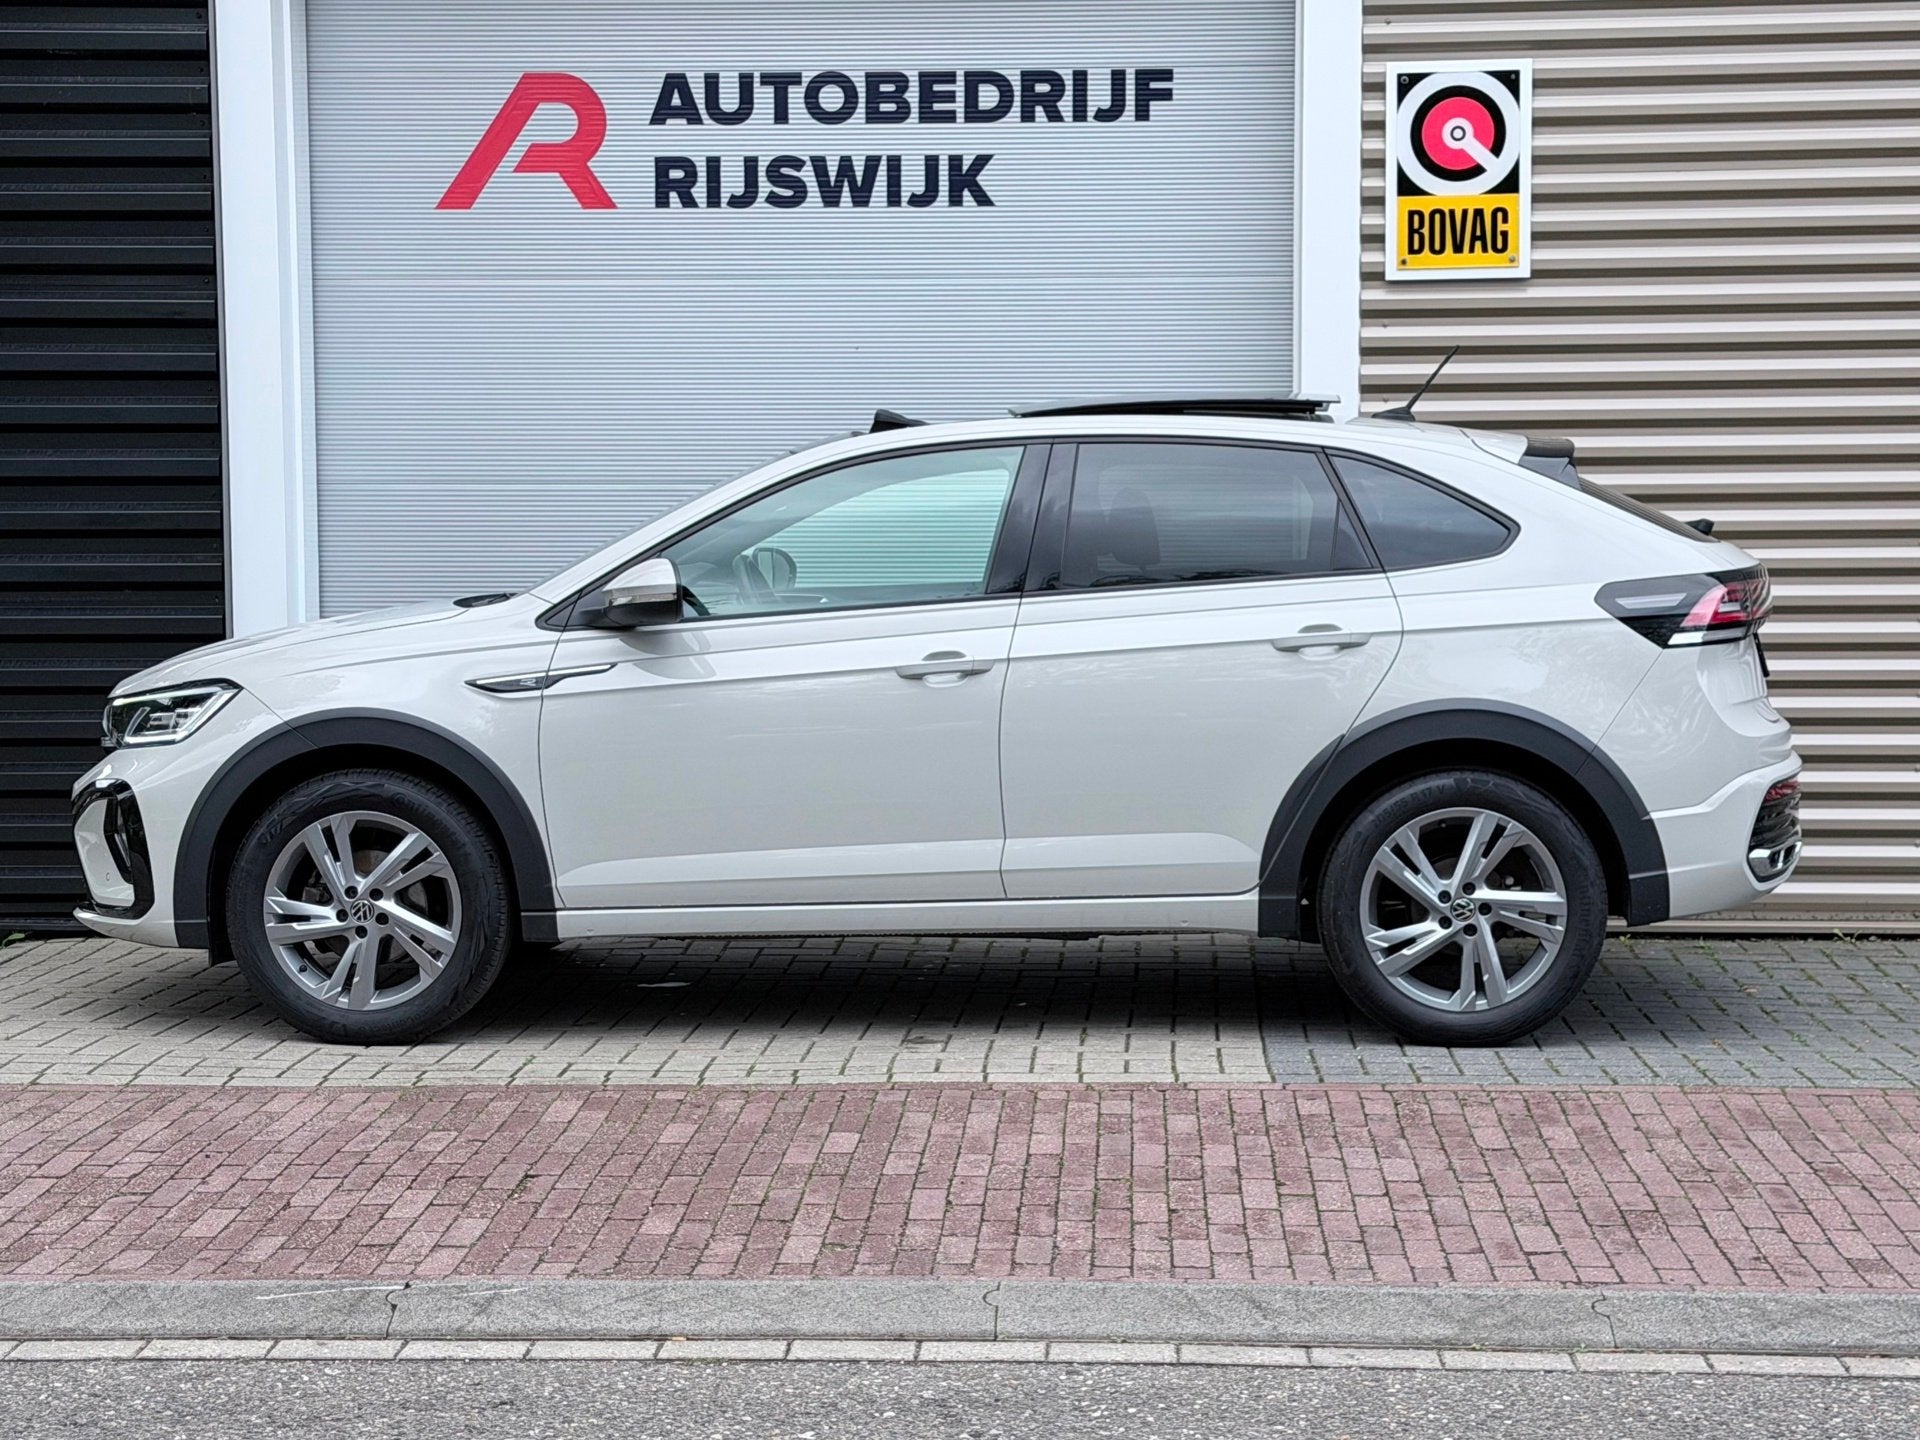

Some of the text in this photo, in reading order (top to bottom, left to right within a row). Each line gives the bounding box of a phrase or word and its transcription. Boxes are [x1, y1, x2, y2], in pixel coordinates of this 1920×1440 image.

[649, 69, 1173, 125] AUTOBEDRIJF
[655, 154, 995, 208] RIJSWIJK
[1407, 207, 1509, 255] BOVAG
